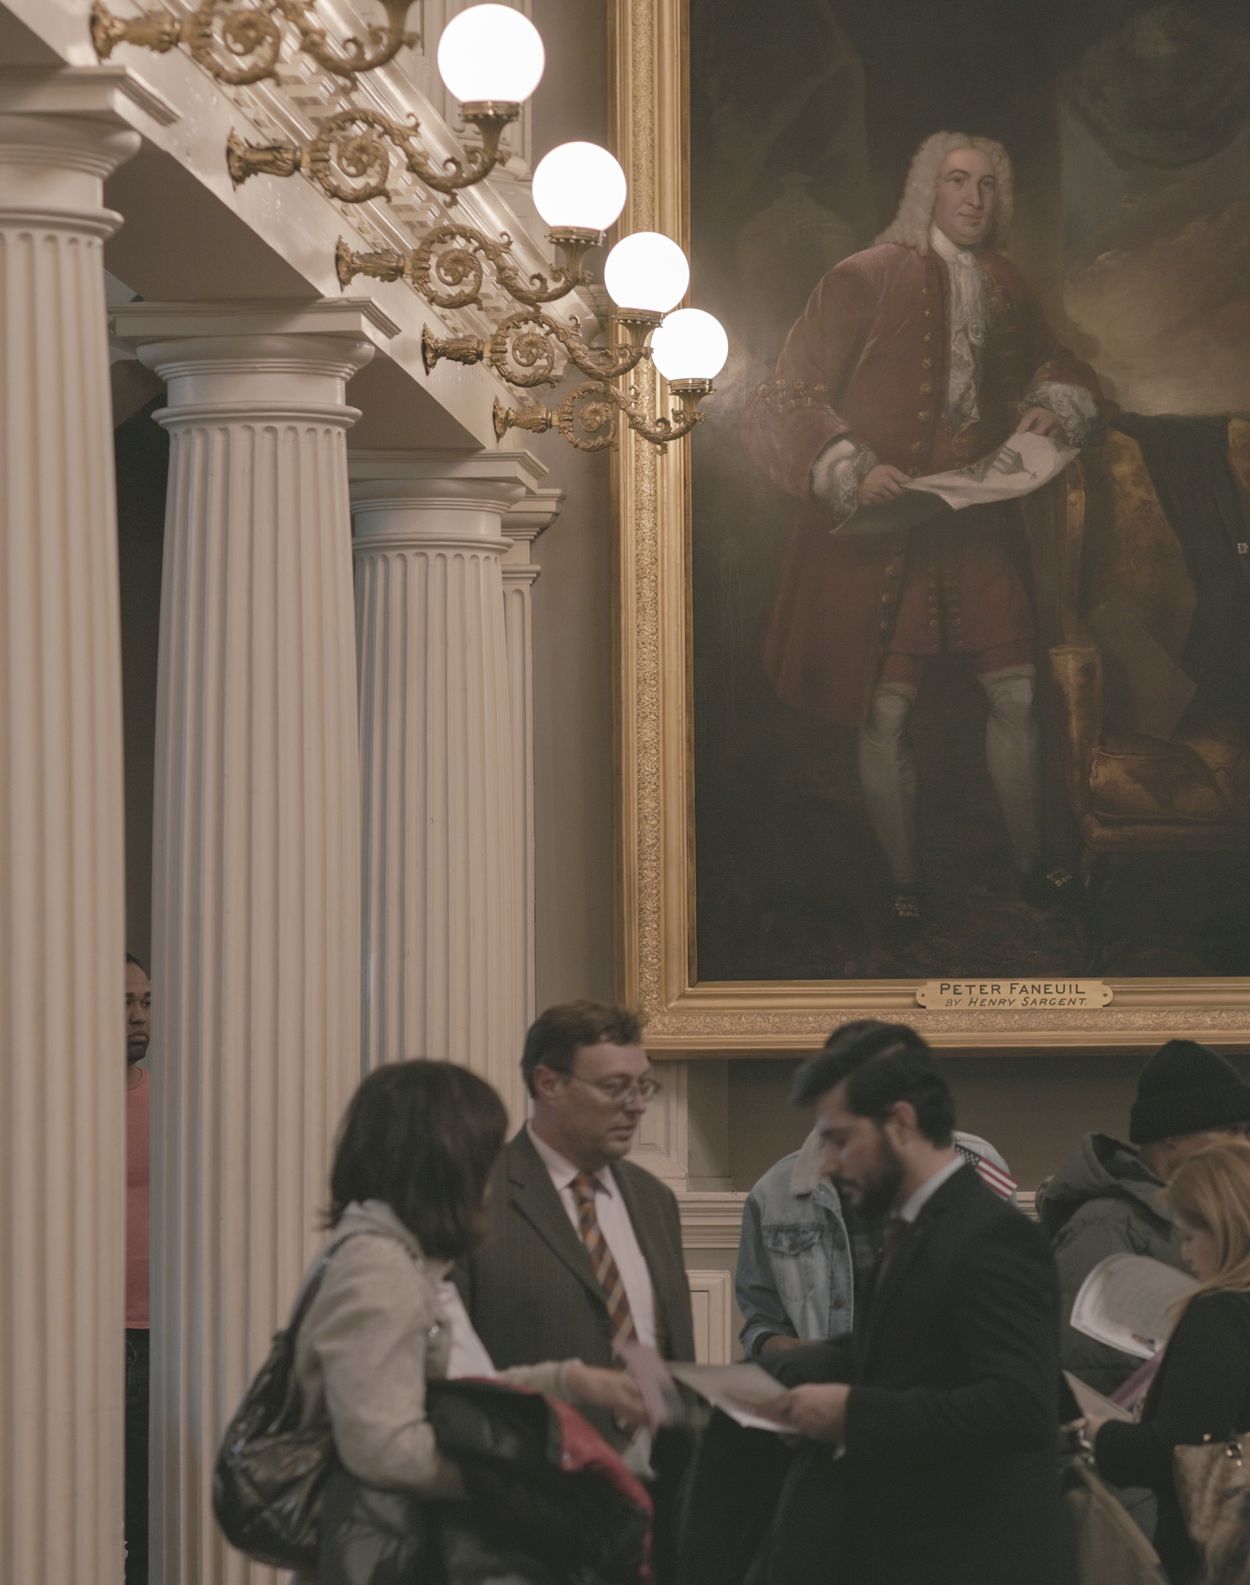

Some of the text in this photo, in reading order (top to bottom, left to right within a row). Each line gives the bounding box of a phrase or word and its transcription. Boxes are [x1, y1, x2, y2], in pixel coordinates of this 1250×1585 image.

[939, 982, 1086, 995] PETER FANEUIL
[944, 998, 961, 1007] BY
[968, 997, 1016, 1007] HENRY
